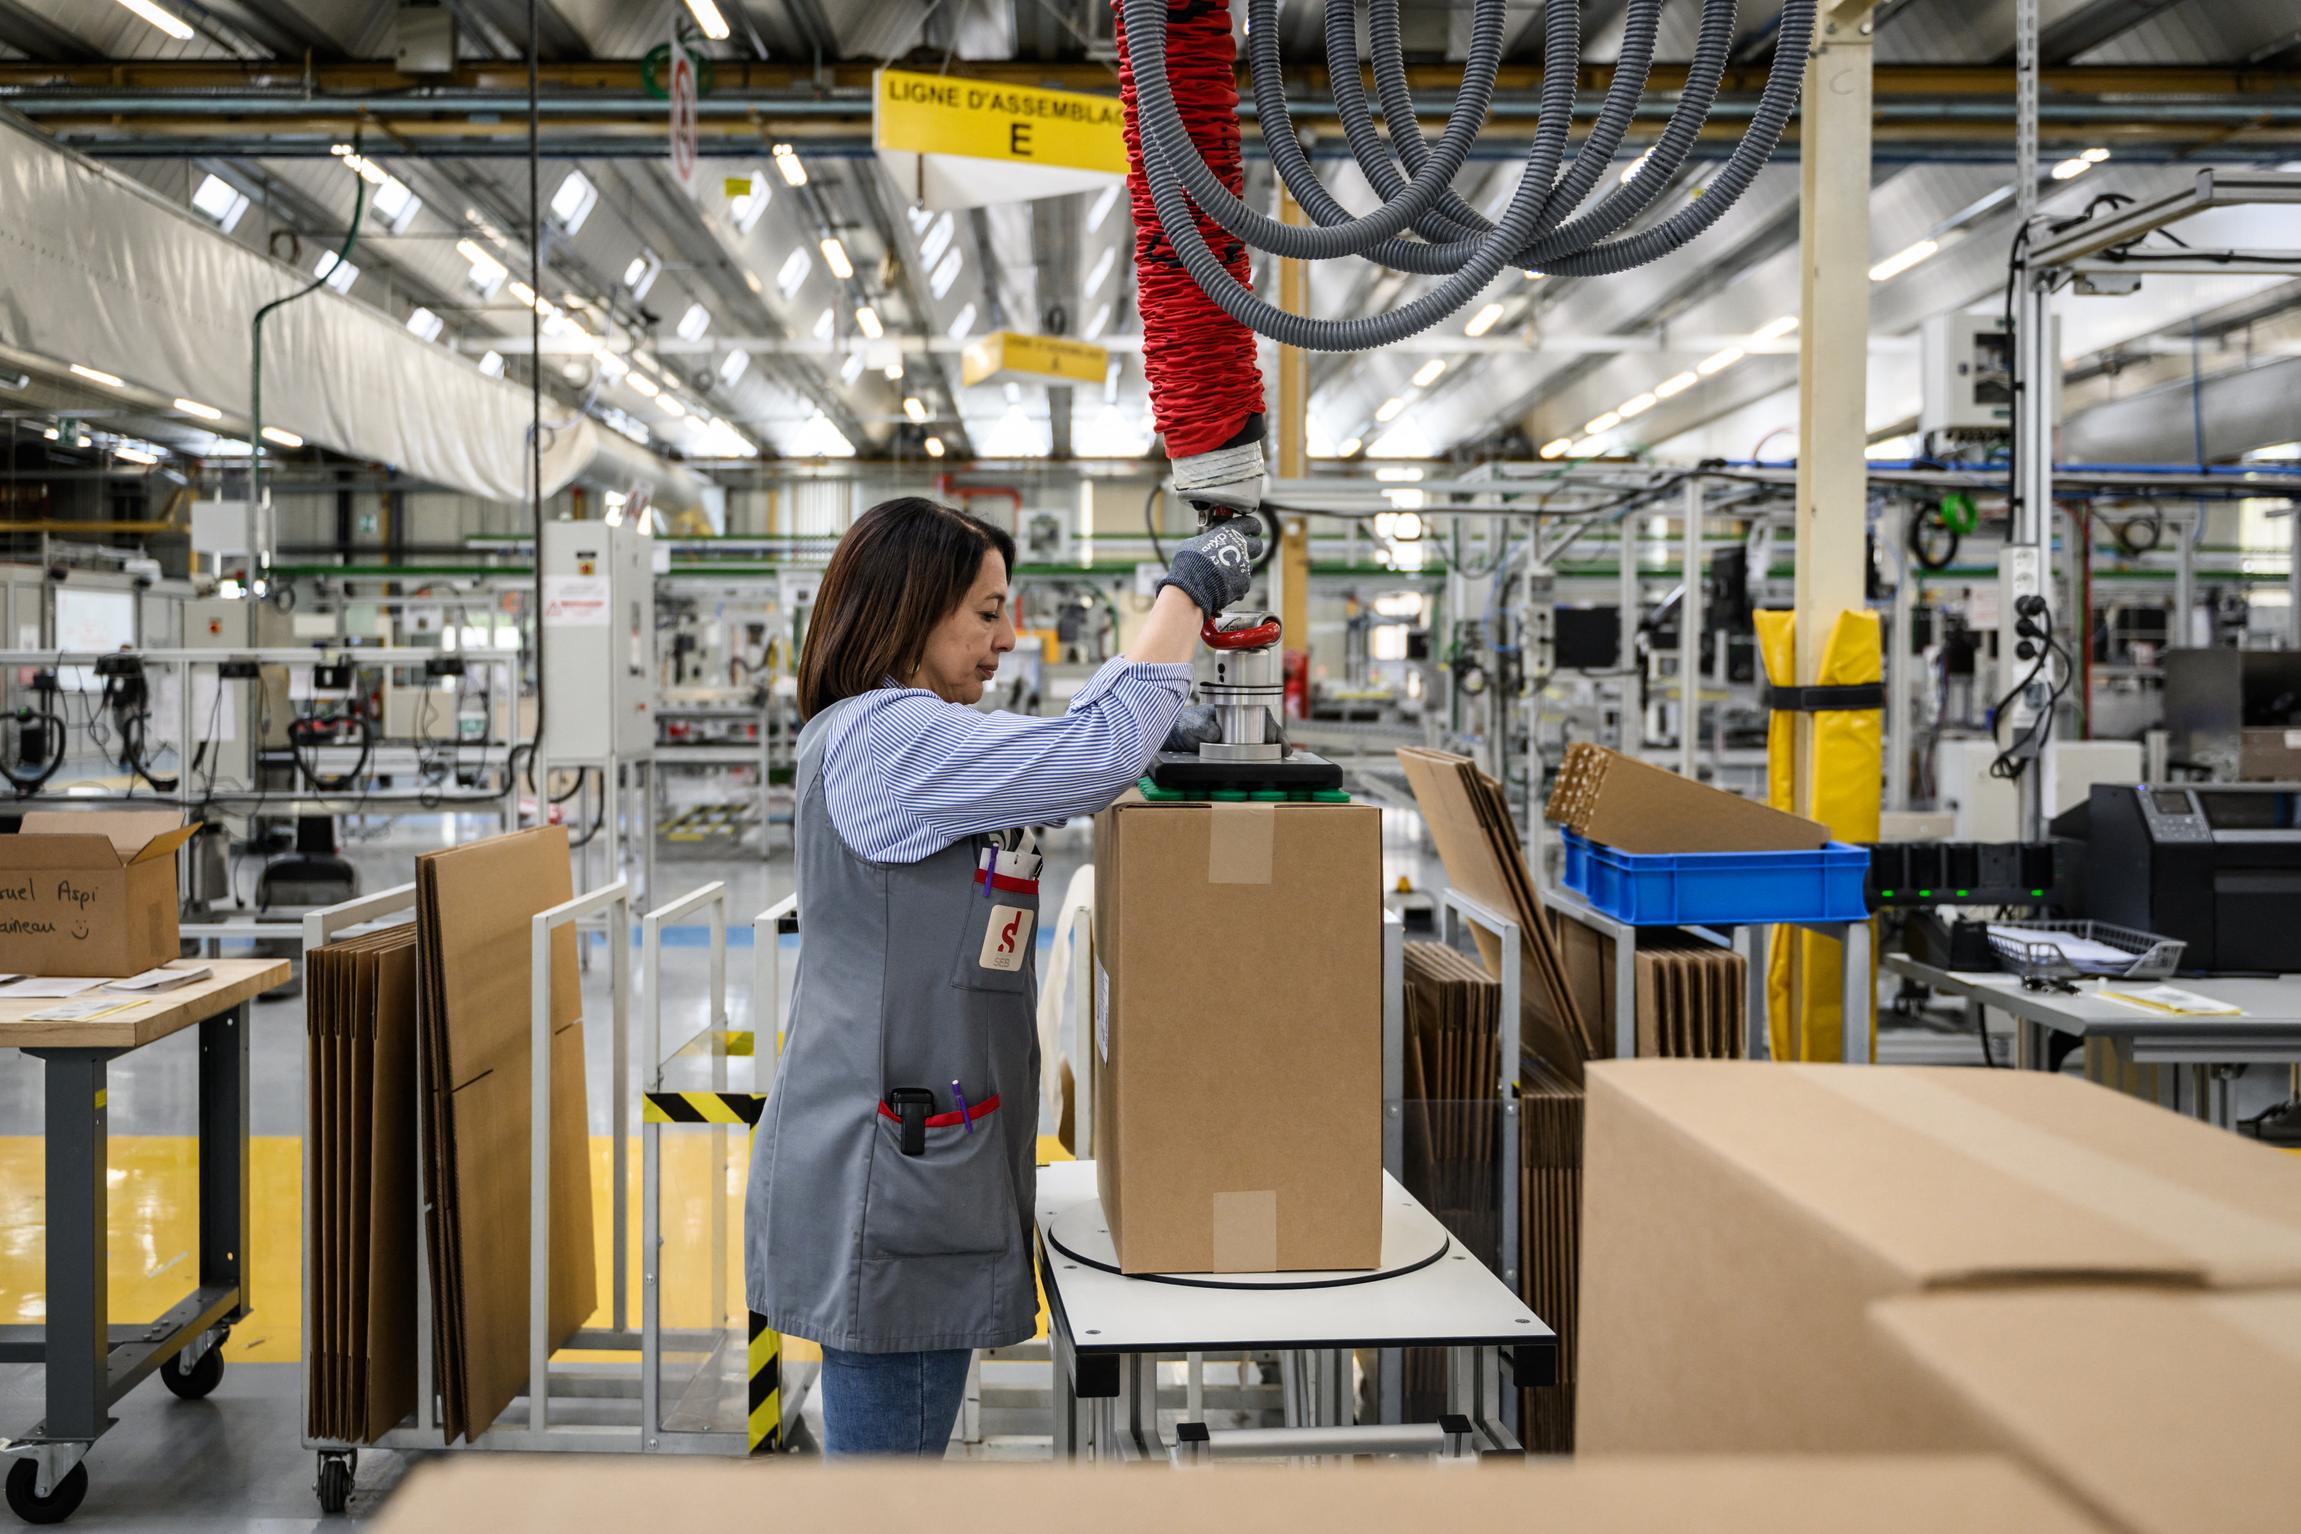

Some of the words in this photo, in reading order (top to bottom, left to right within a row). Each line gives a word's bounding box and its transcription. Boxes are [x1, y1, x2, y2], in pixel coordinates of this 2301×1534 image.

[888, 80, 960, 107] LIGNE
[1010, 123, 1032, 156] E
[57, 879, 99, 911] Aspi
[993, 956, 1010, 968] SEB
